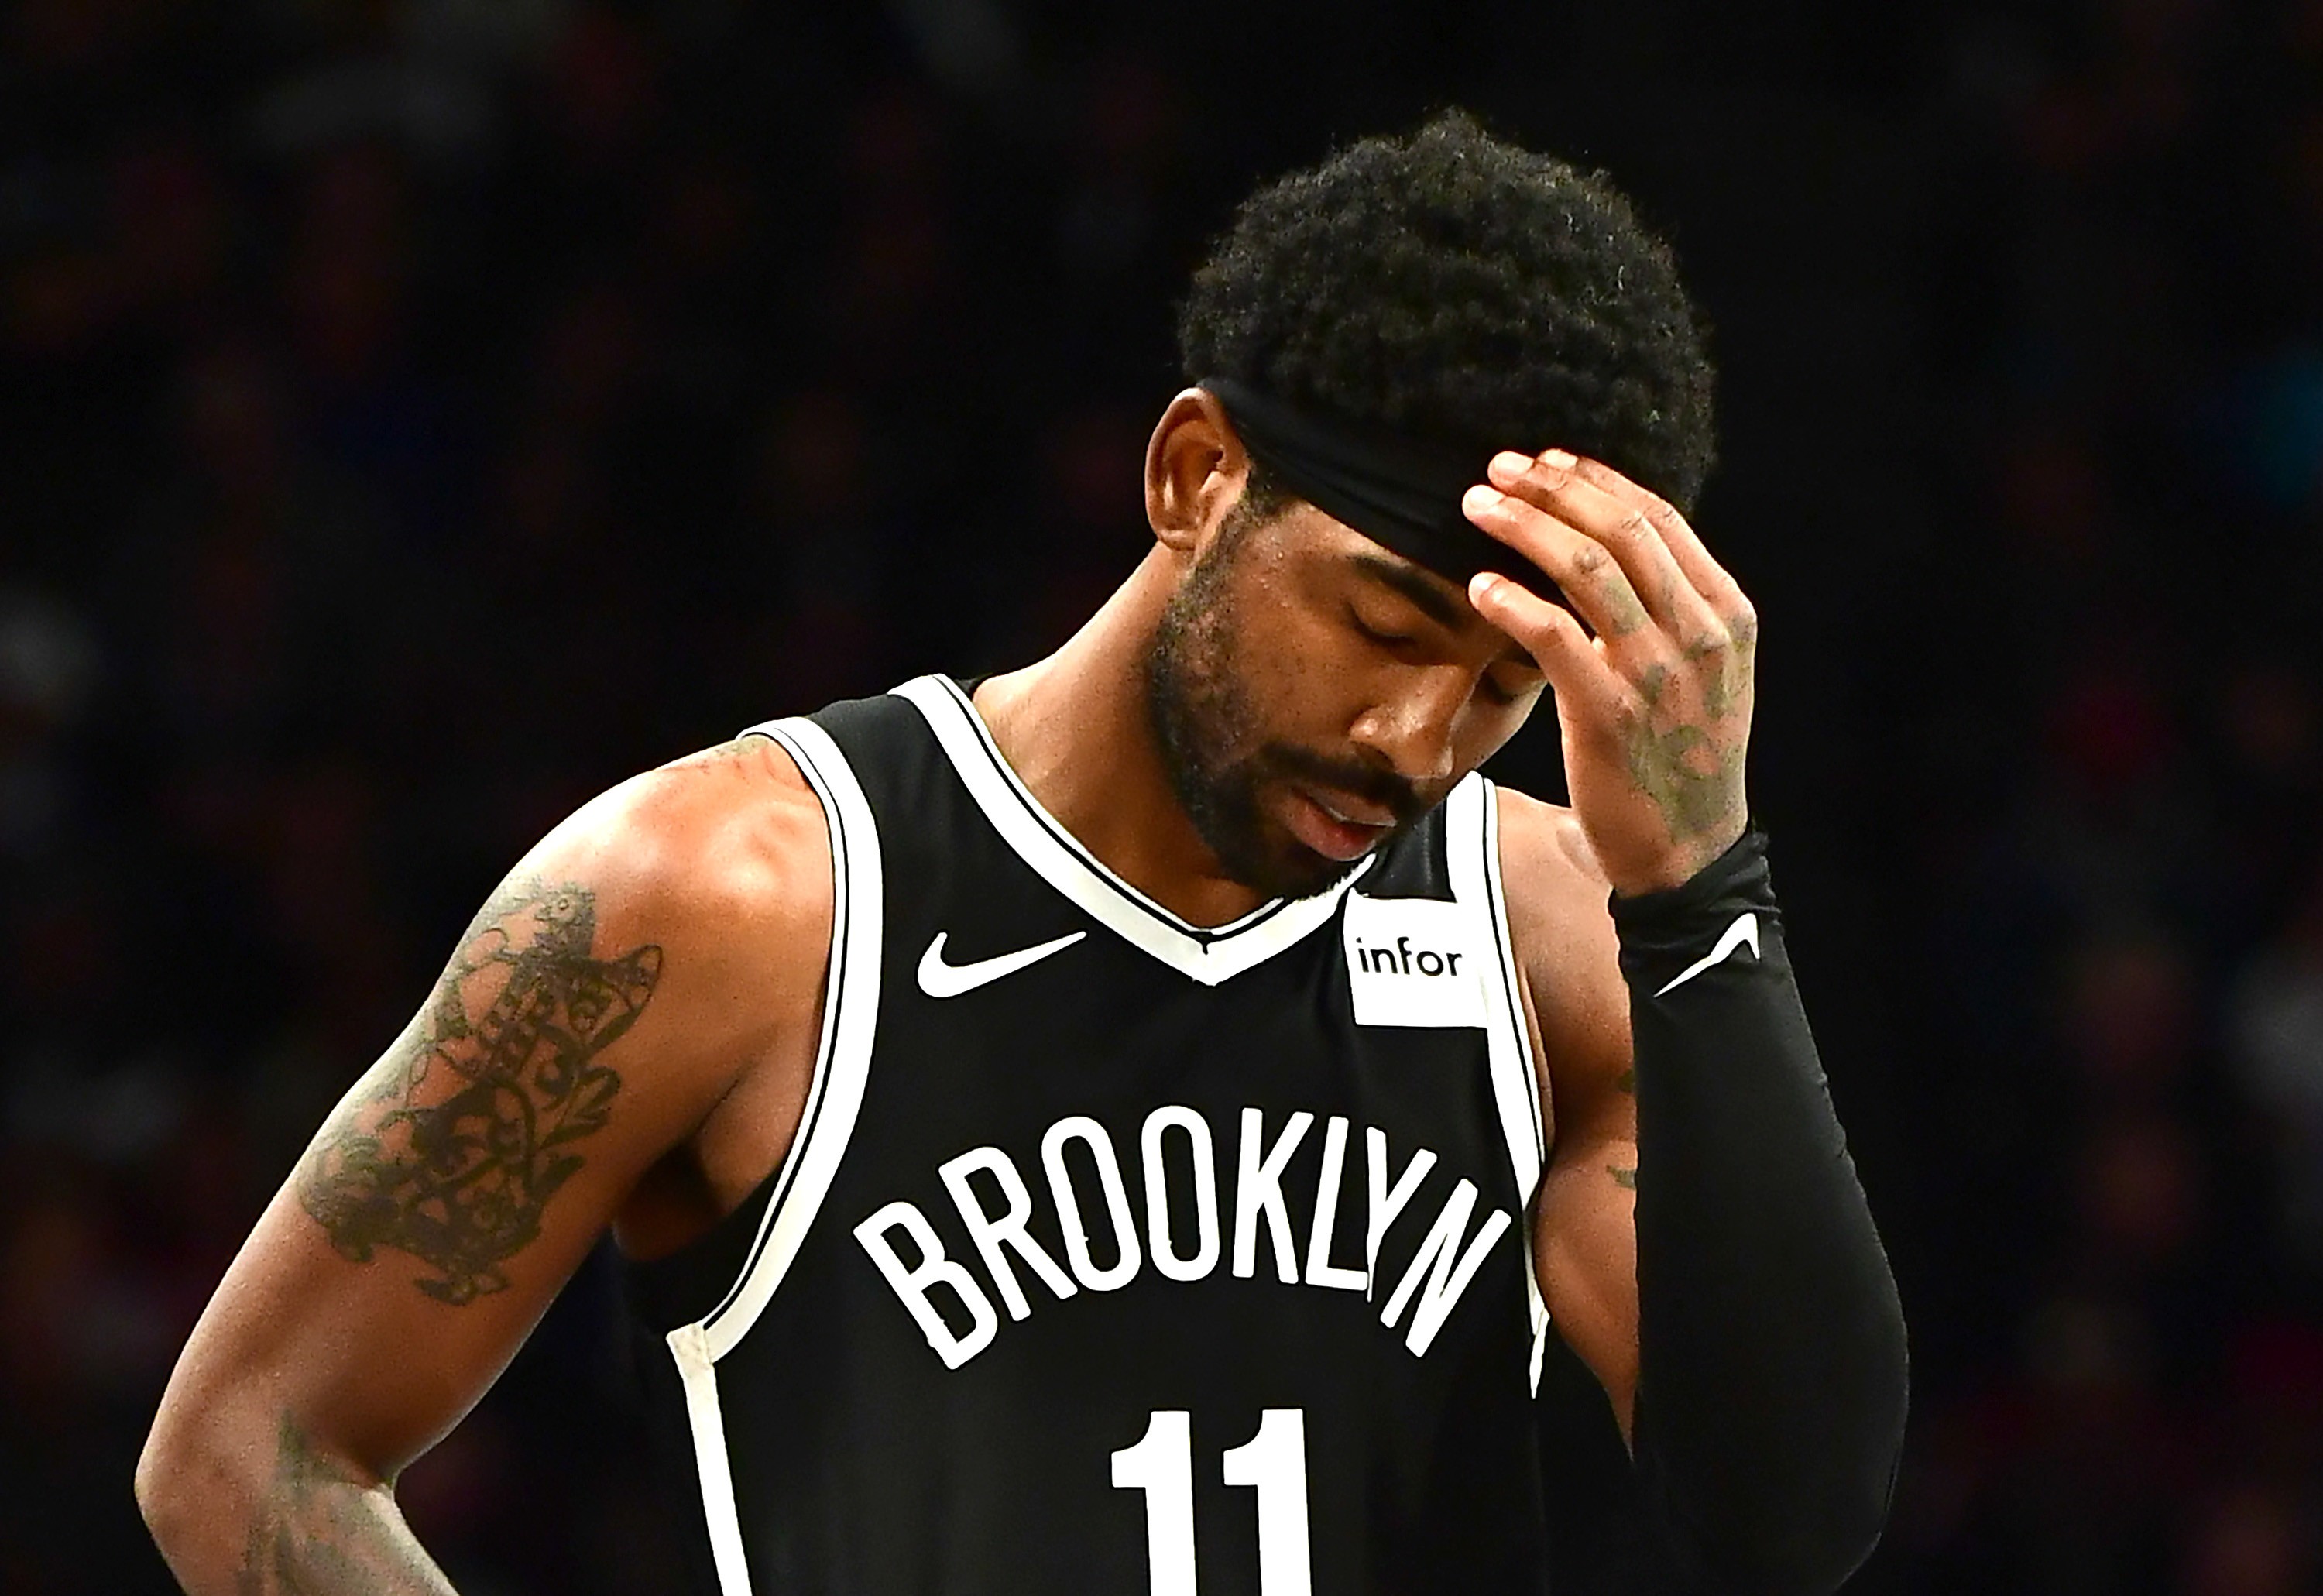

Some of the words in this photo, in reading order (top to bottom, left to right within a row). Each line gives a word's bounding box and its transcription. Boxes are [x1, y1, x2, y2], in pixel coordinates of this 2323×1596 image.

[1356, 936, 1463, 977] infor
[853, 1105, 1512, 1370] BROOKLYN
[1111, 1408, 1312, 1596] 11
